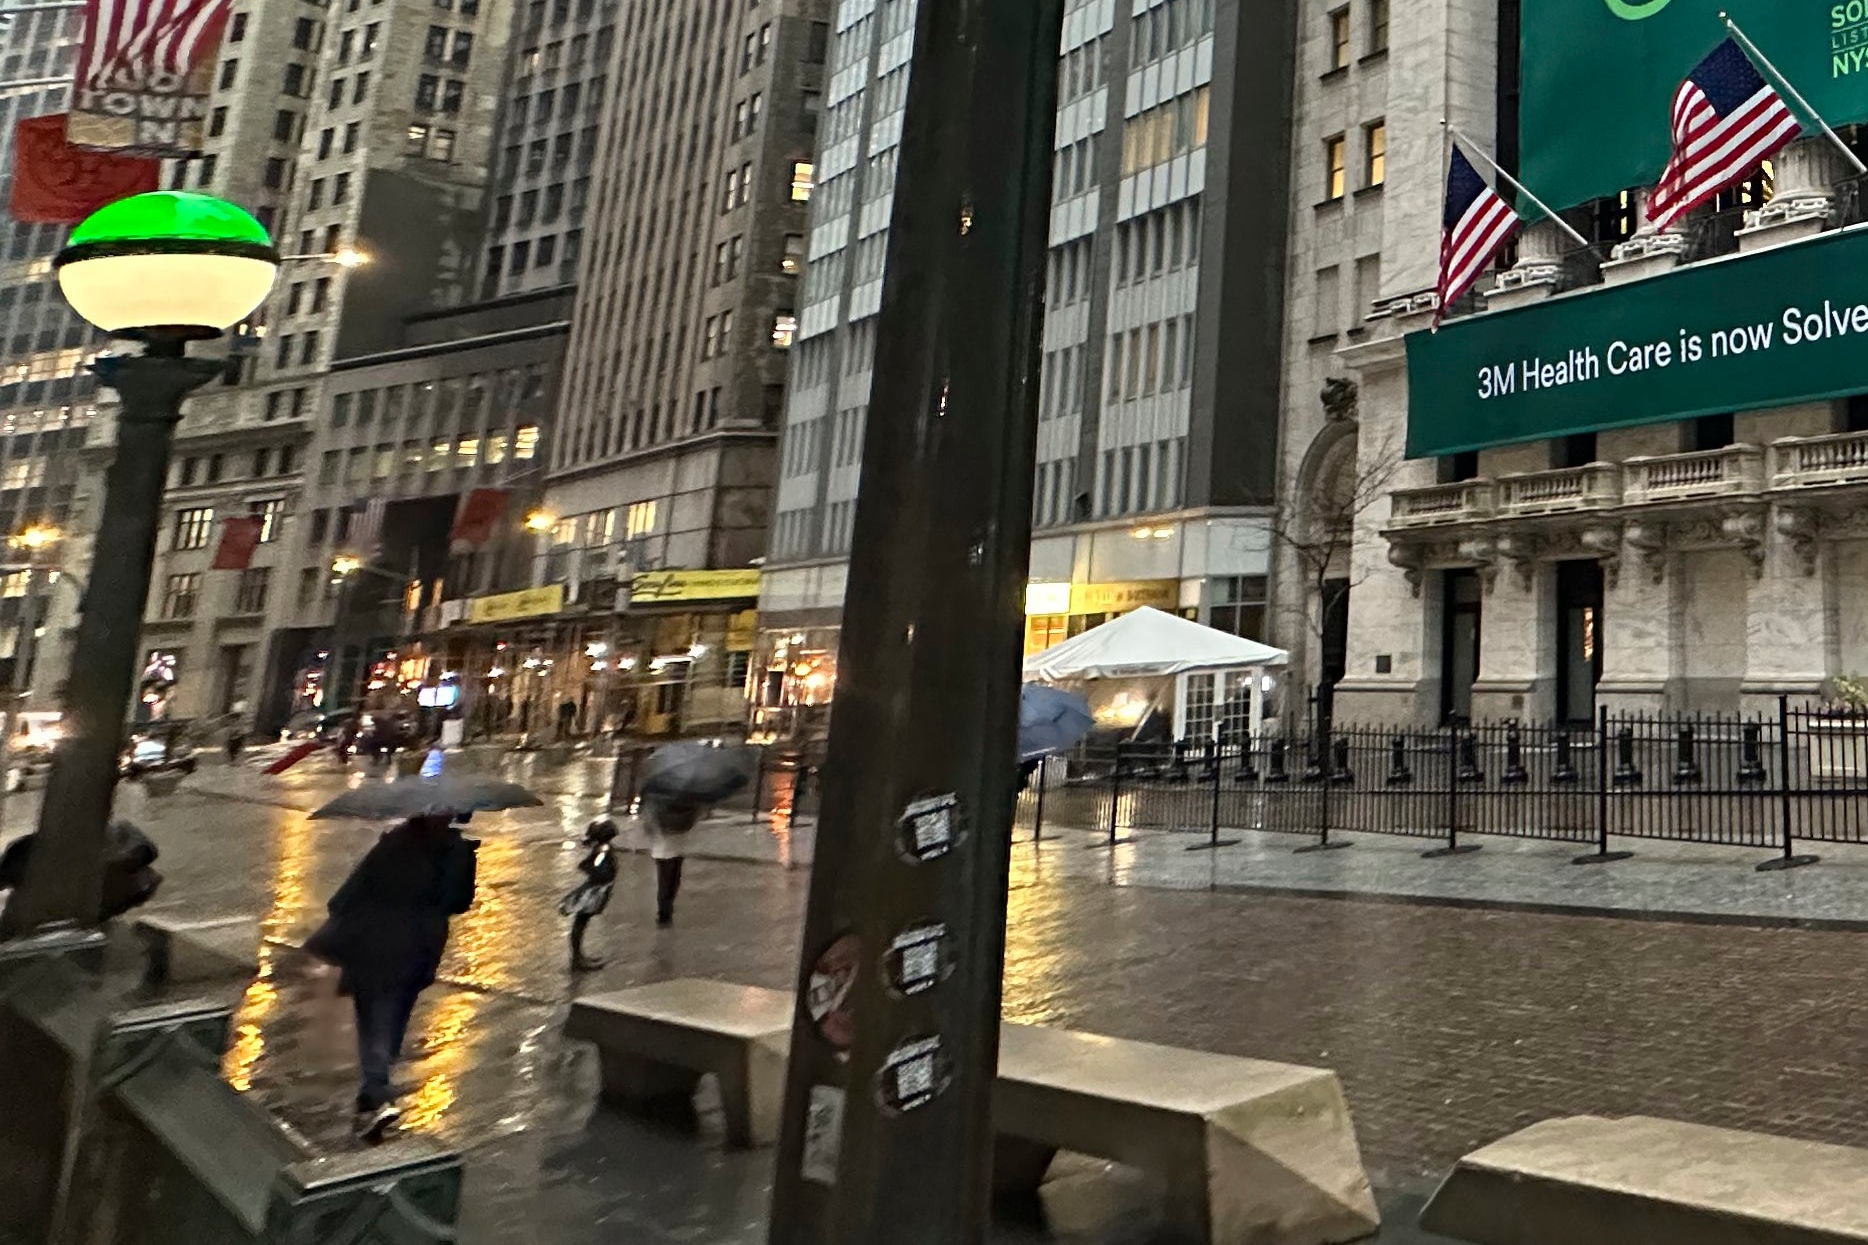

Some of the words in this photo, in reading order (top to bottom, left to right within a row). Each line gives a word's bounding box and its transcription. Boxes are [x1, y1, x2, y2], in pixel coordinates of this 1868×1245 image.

[1478, 363, 1514, 398] 3M
[1523, 347, 1599, 391] Health
[1607, 341, 1672, 375] Care
[1679, 328, 1702, 362] is
[1711, 322, 1774, 357] now
